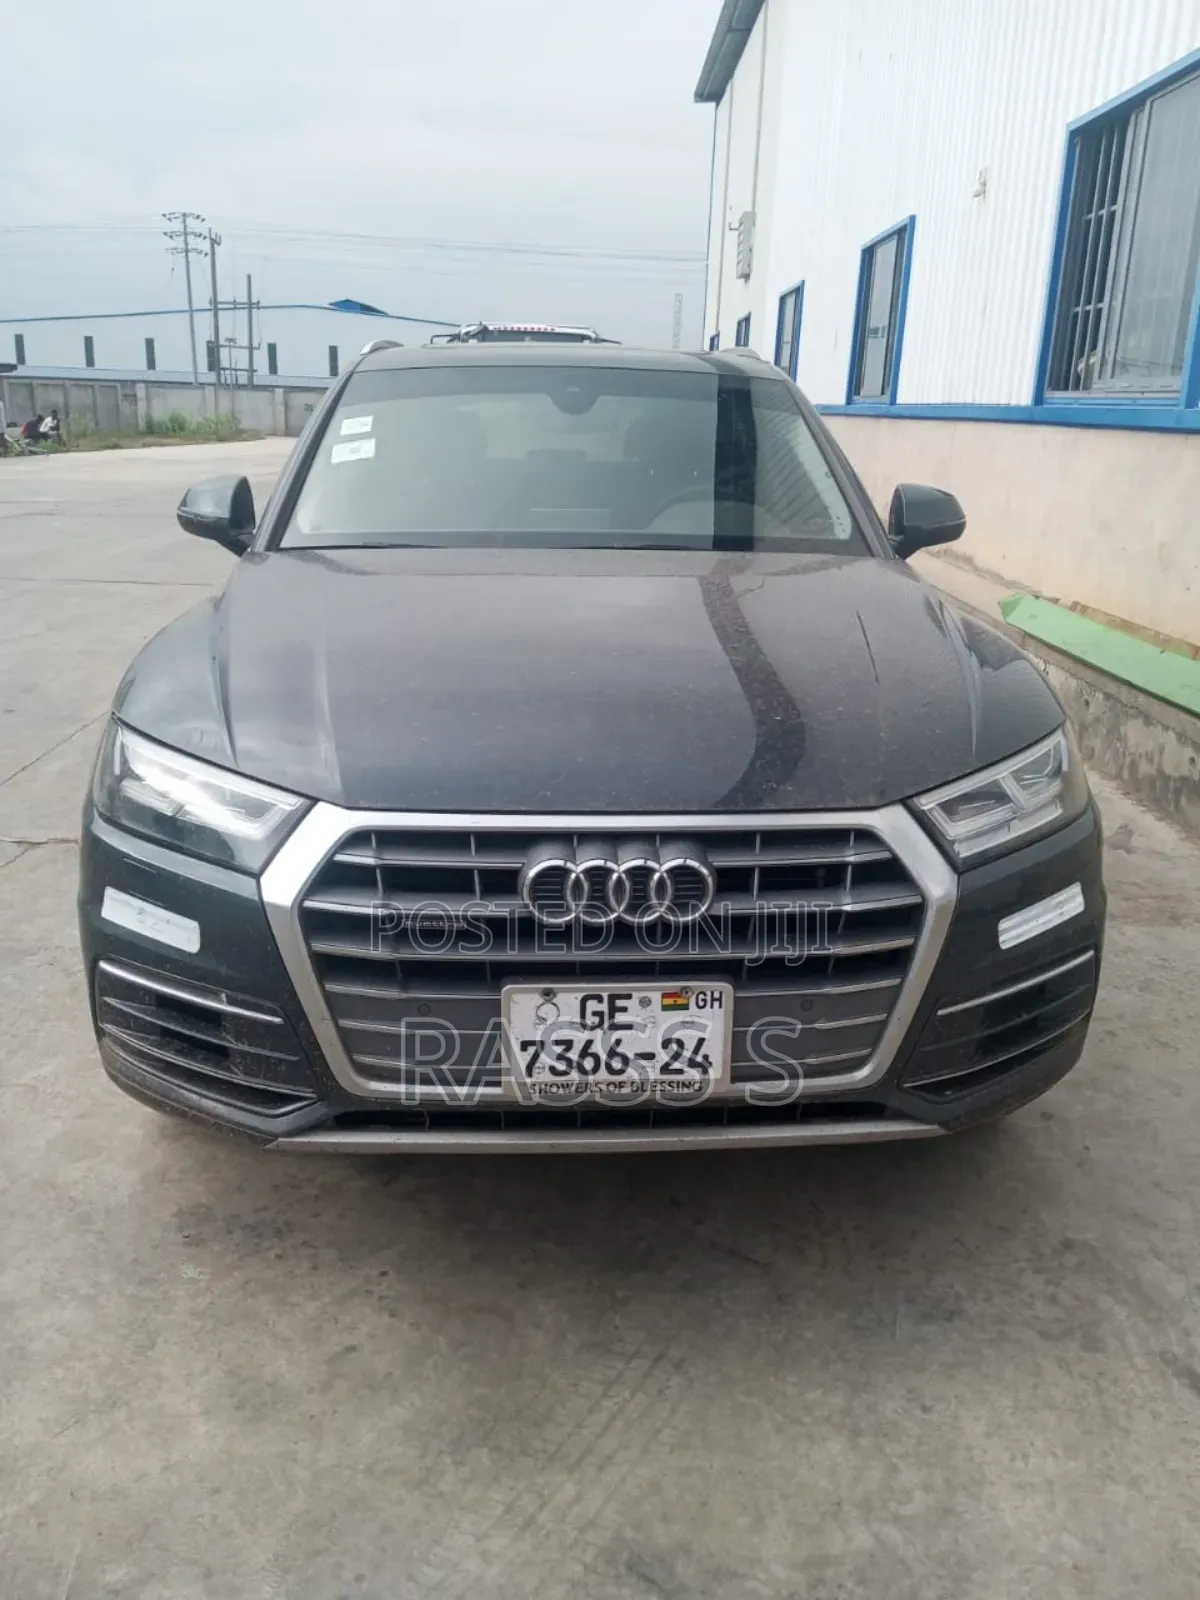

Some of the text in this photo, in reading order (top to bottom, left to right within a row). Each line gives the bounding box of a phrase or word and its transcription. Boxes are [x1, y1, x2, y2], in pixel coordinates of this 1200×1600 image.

[579, 993, 634, 1031] GE
[694, 990, 724, 1010] GH
[519, 1036, 713, 1078] 7366-24
[529, 1080, 703, 1095] SHOWERS OF BLESSING
